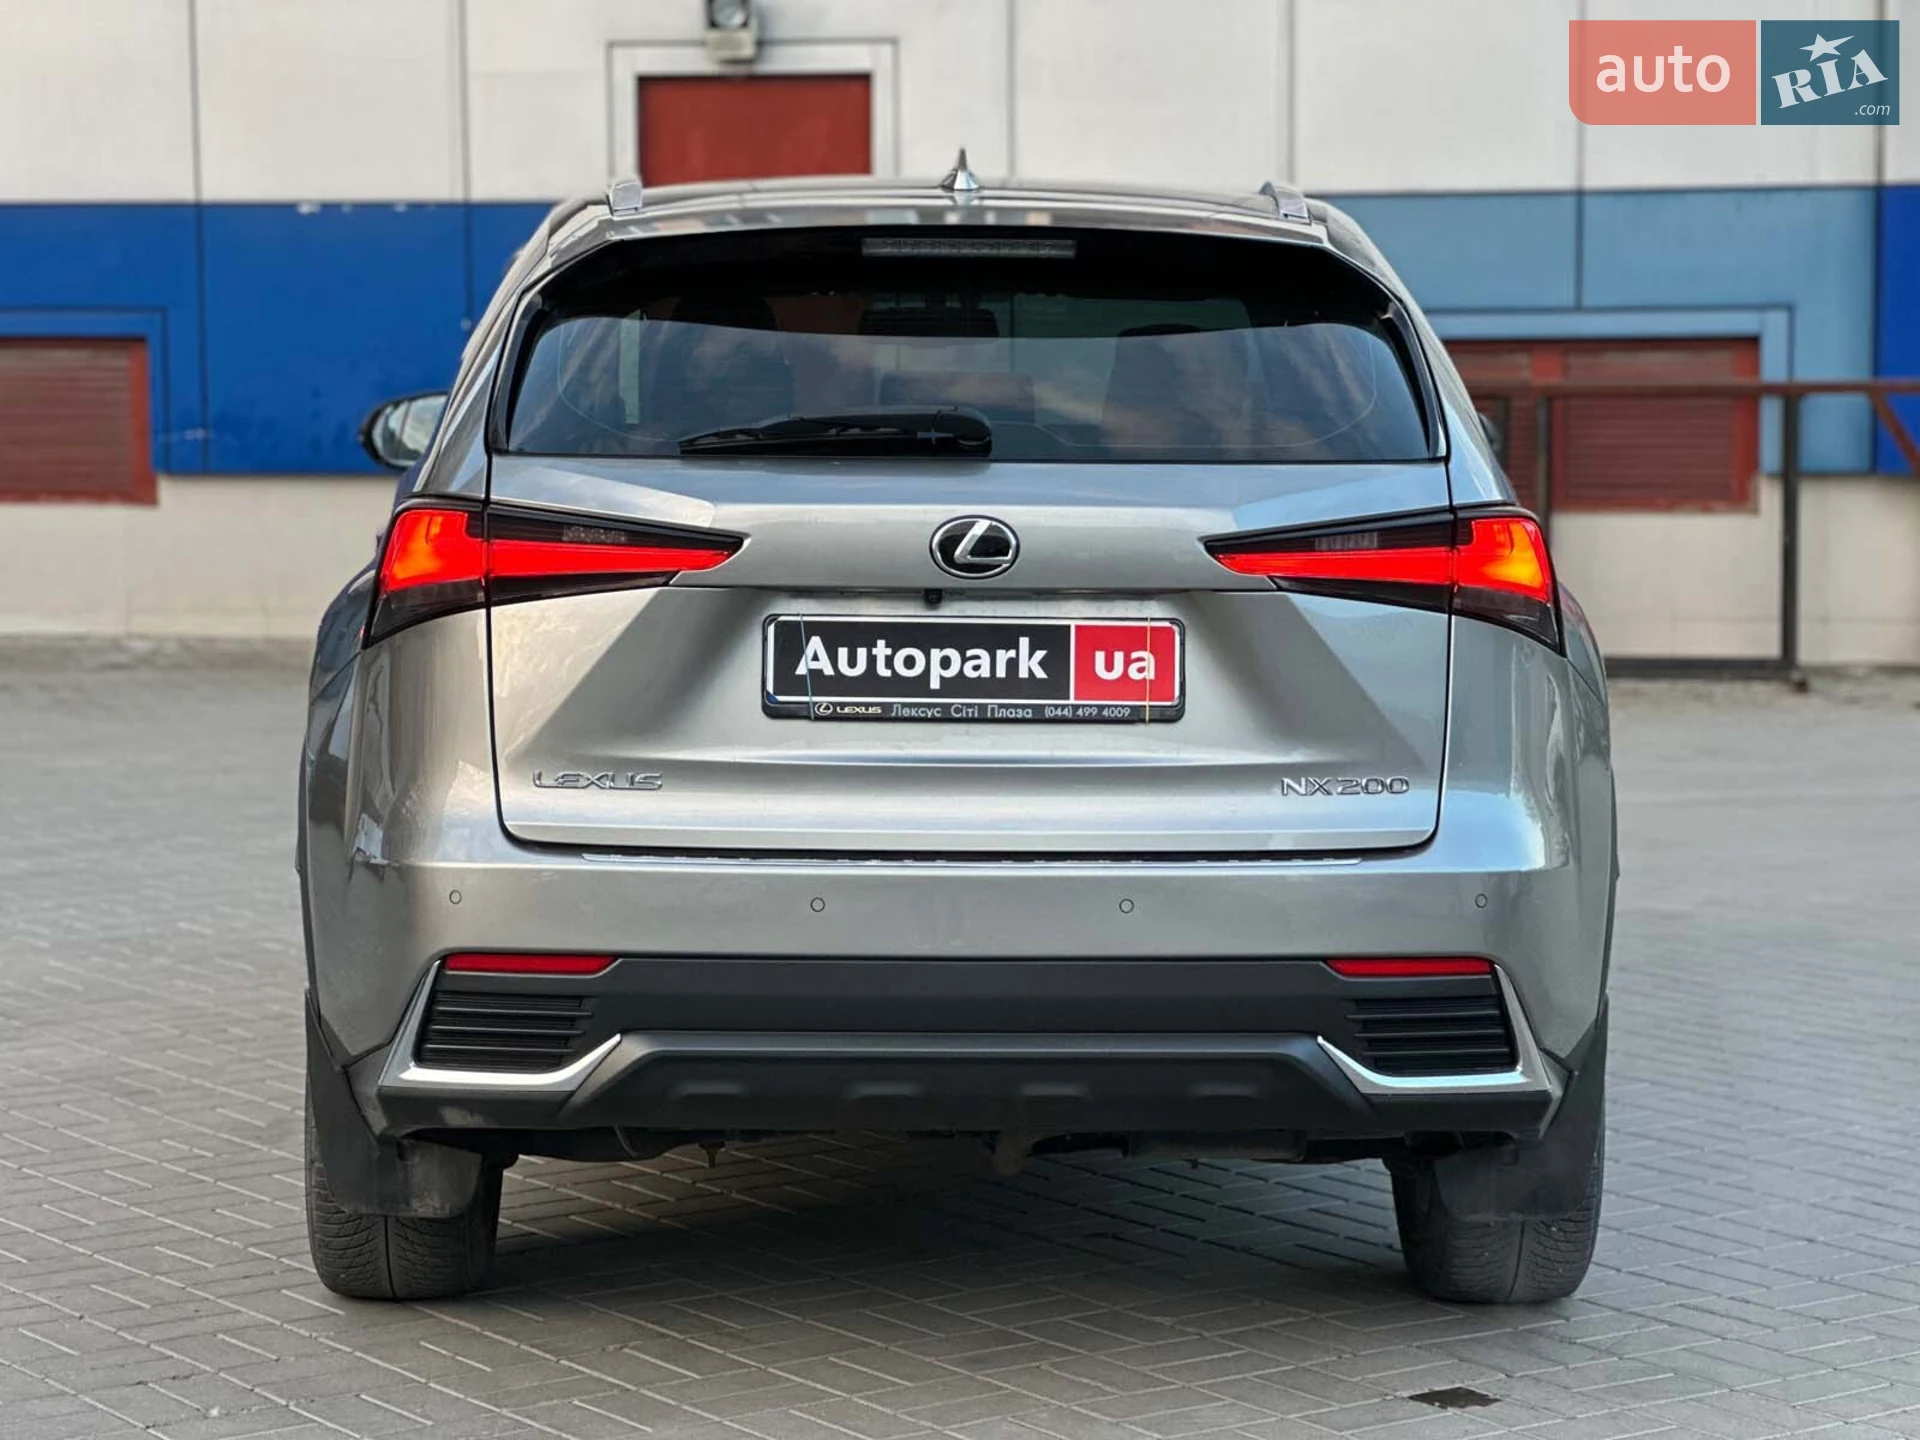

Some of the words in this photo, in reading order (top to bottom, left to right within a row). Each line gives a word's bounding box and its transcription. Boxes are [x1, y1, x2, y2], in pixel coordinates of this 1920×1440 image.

[795, 635, 1049, 689] Autopark
[1094, 650, 1156, 680] ua
[836, 705, 882, 714] LEXUS
[891, 703, 942, 718] Лексус
[987, 705, 1033, 718] Плаза
[1044, 705, 1073, 718] (044)
[1076, 706, 1098, 717] 499
[1102, 706, 1131, 717] 4009
[532, 770, 663, 791] LEXUS
